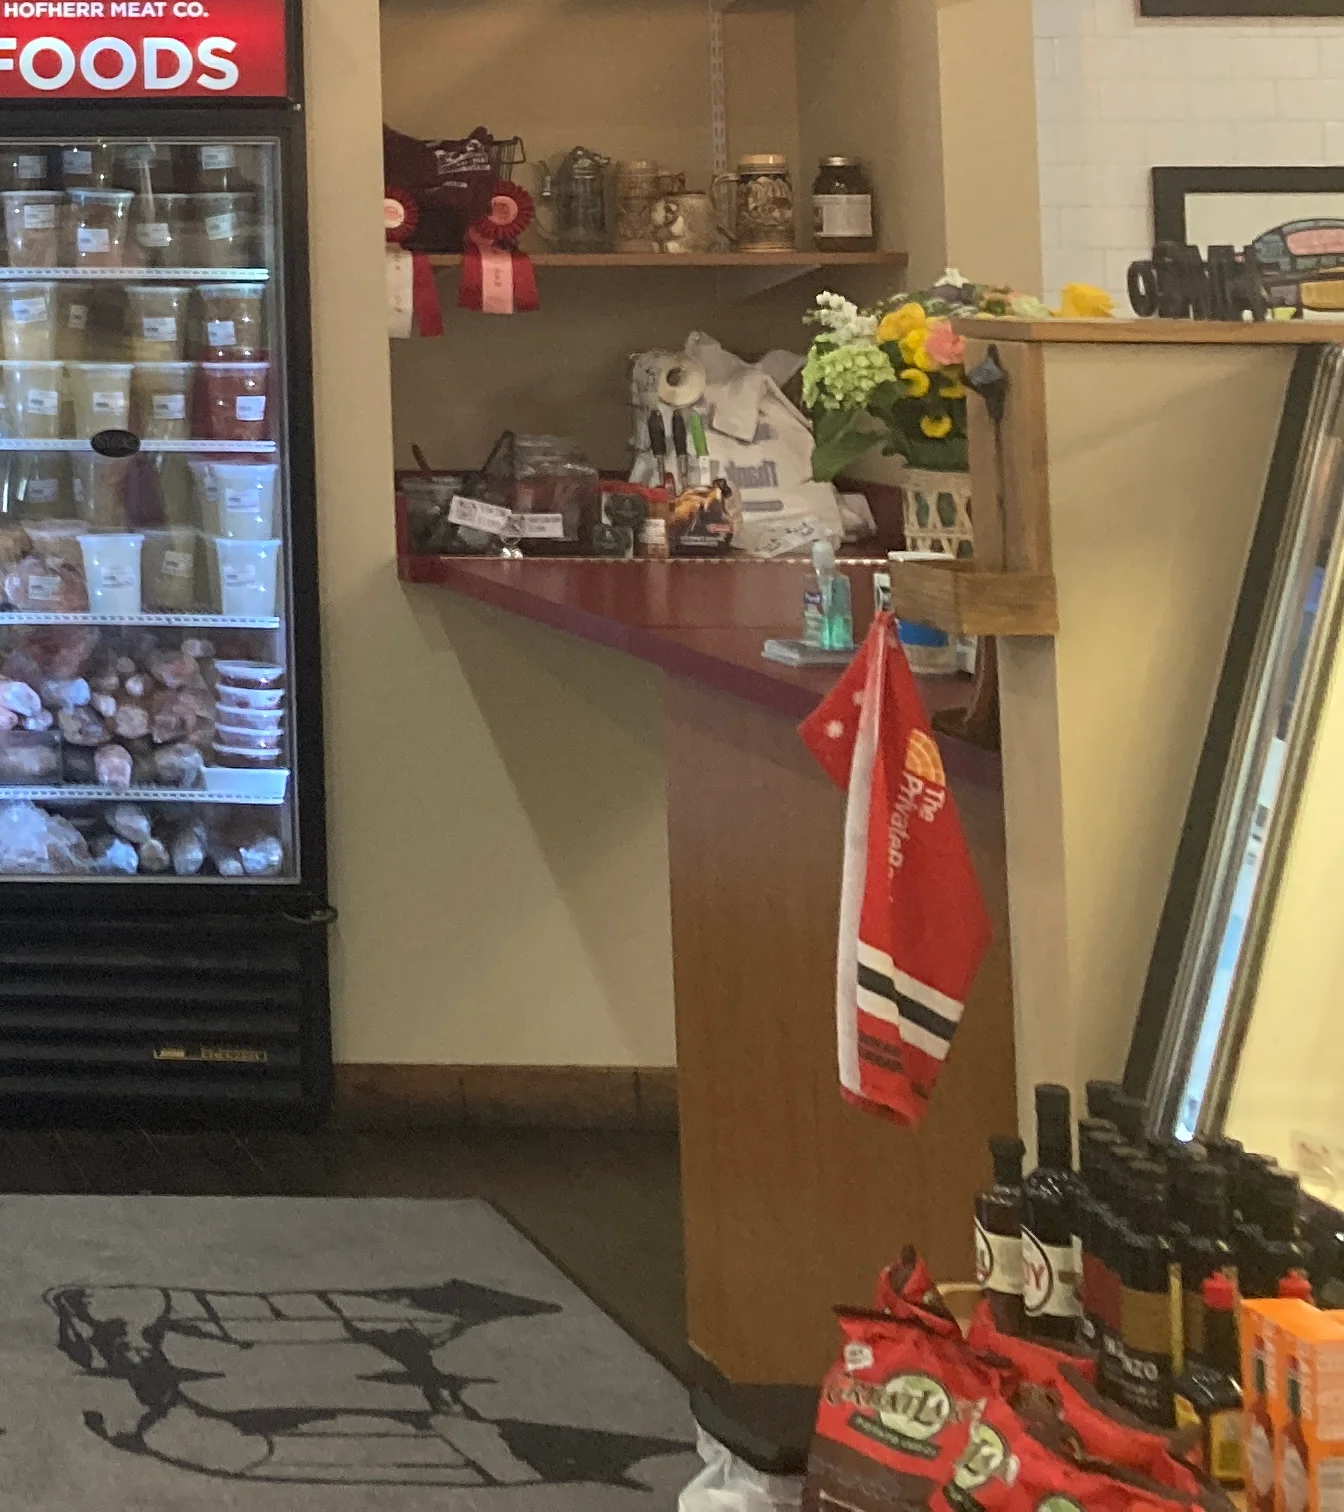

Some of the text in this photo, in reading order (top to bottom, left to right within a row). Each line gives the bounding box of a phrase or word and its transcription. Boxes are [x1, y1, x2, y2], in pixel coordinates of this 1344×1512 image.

[3, 1, 209, 19] HOFHERR MEAT CO.
[919, 788, 946, 823] The
